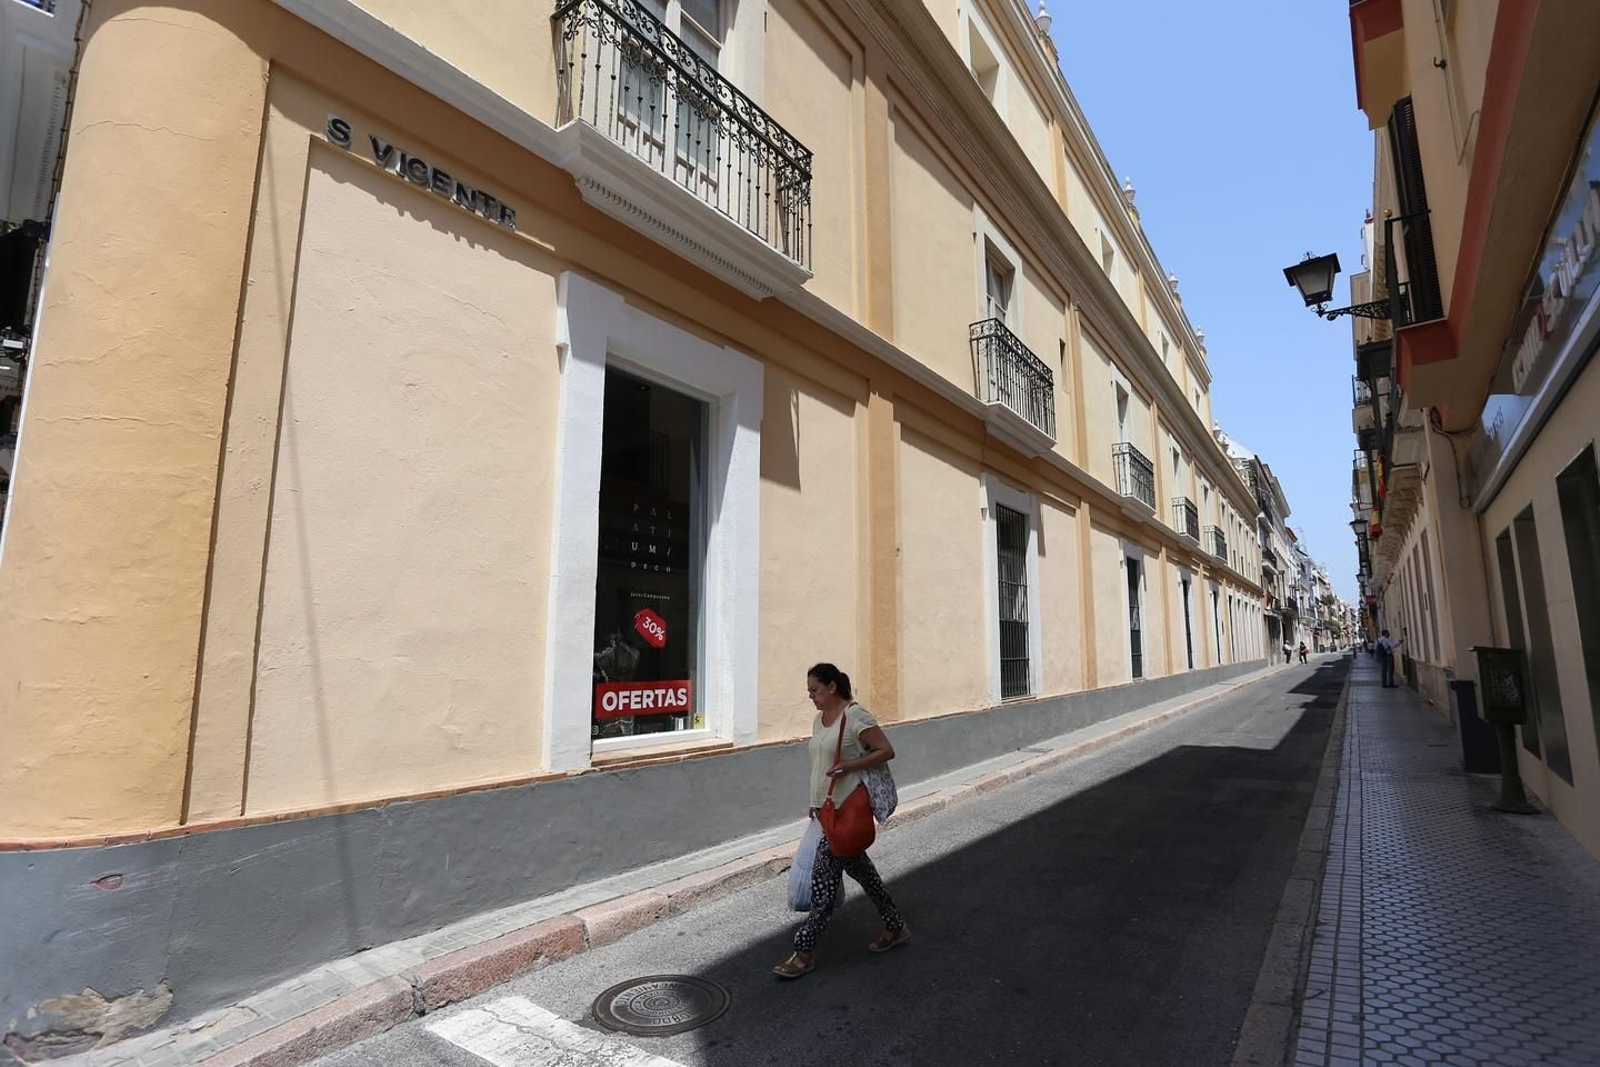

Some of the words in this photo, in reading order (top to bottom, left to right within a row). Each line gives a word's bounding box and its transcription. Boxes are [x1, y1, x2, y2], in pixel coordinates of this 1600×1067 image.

[327, 117, 351, 149] S
[369, 134, 516, 231] VICENTE
[630, 561, 672, 573] DECO
[642, 616, 665, 641] 30%
[601, 688, 687, 711] OFERTAS
